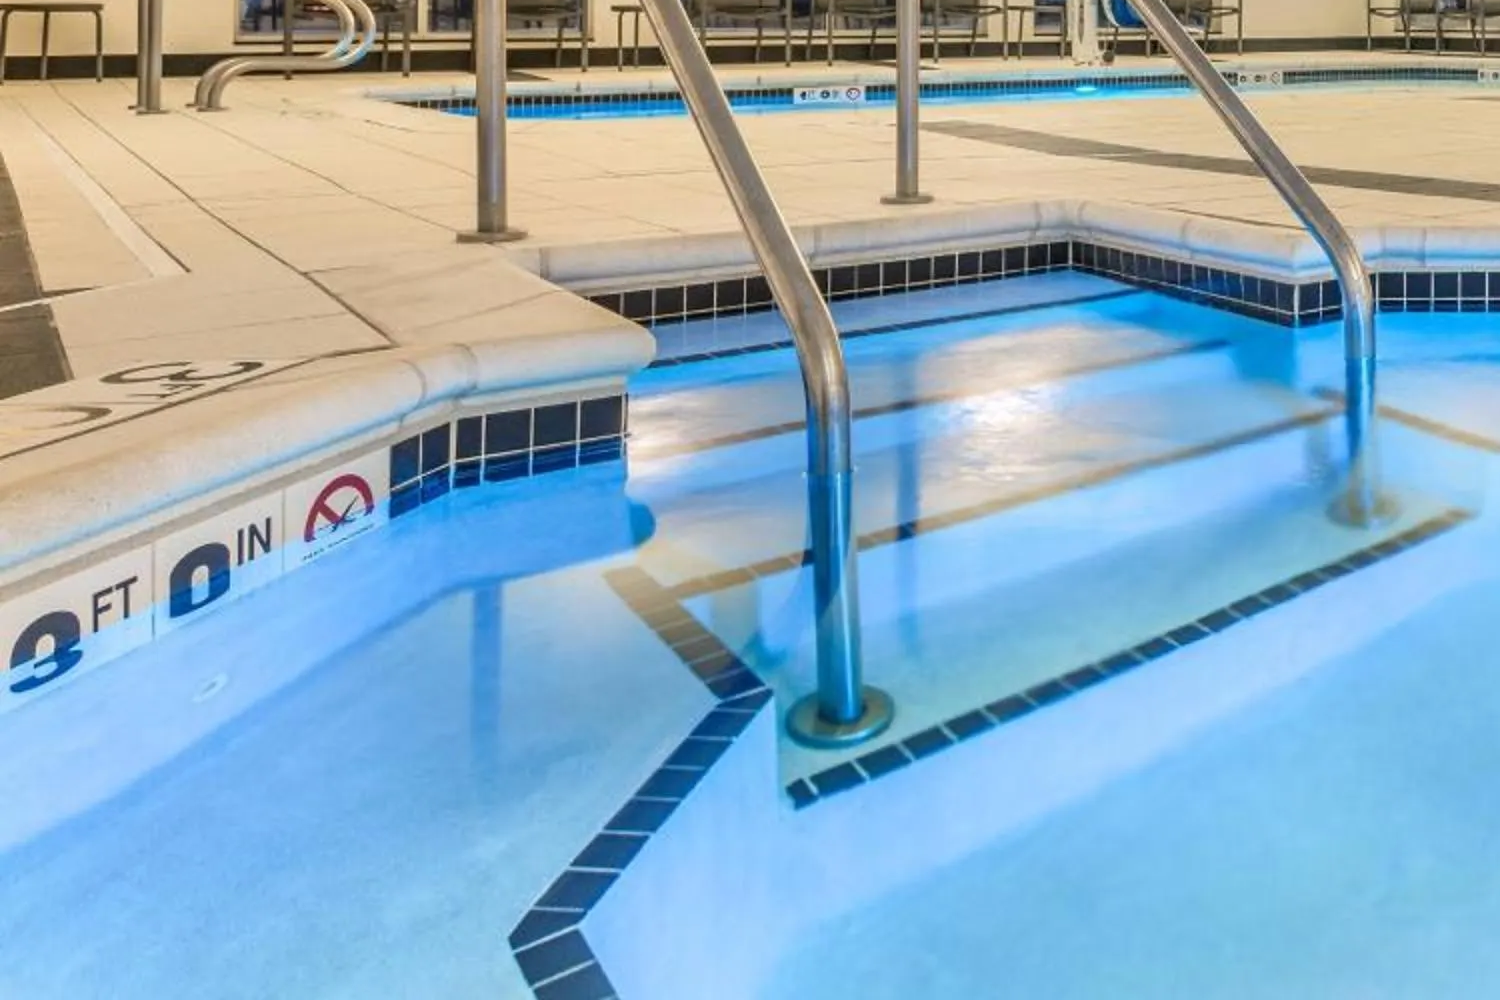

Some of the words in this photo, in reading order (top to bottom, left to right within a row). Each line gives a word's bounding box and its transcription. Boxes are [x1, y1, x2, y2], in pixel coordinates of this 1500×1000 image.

[9, 609, 84, 693] 3
[91, 575, 138, 633] FT
[168, 541, 231, 619] 0
[236, 517, 273, 566] IN
